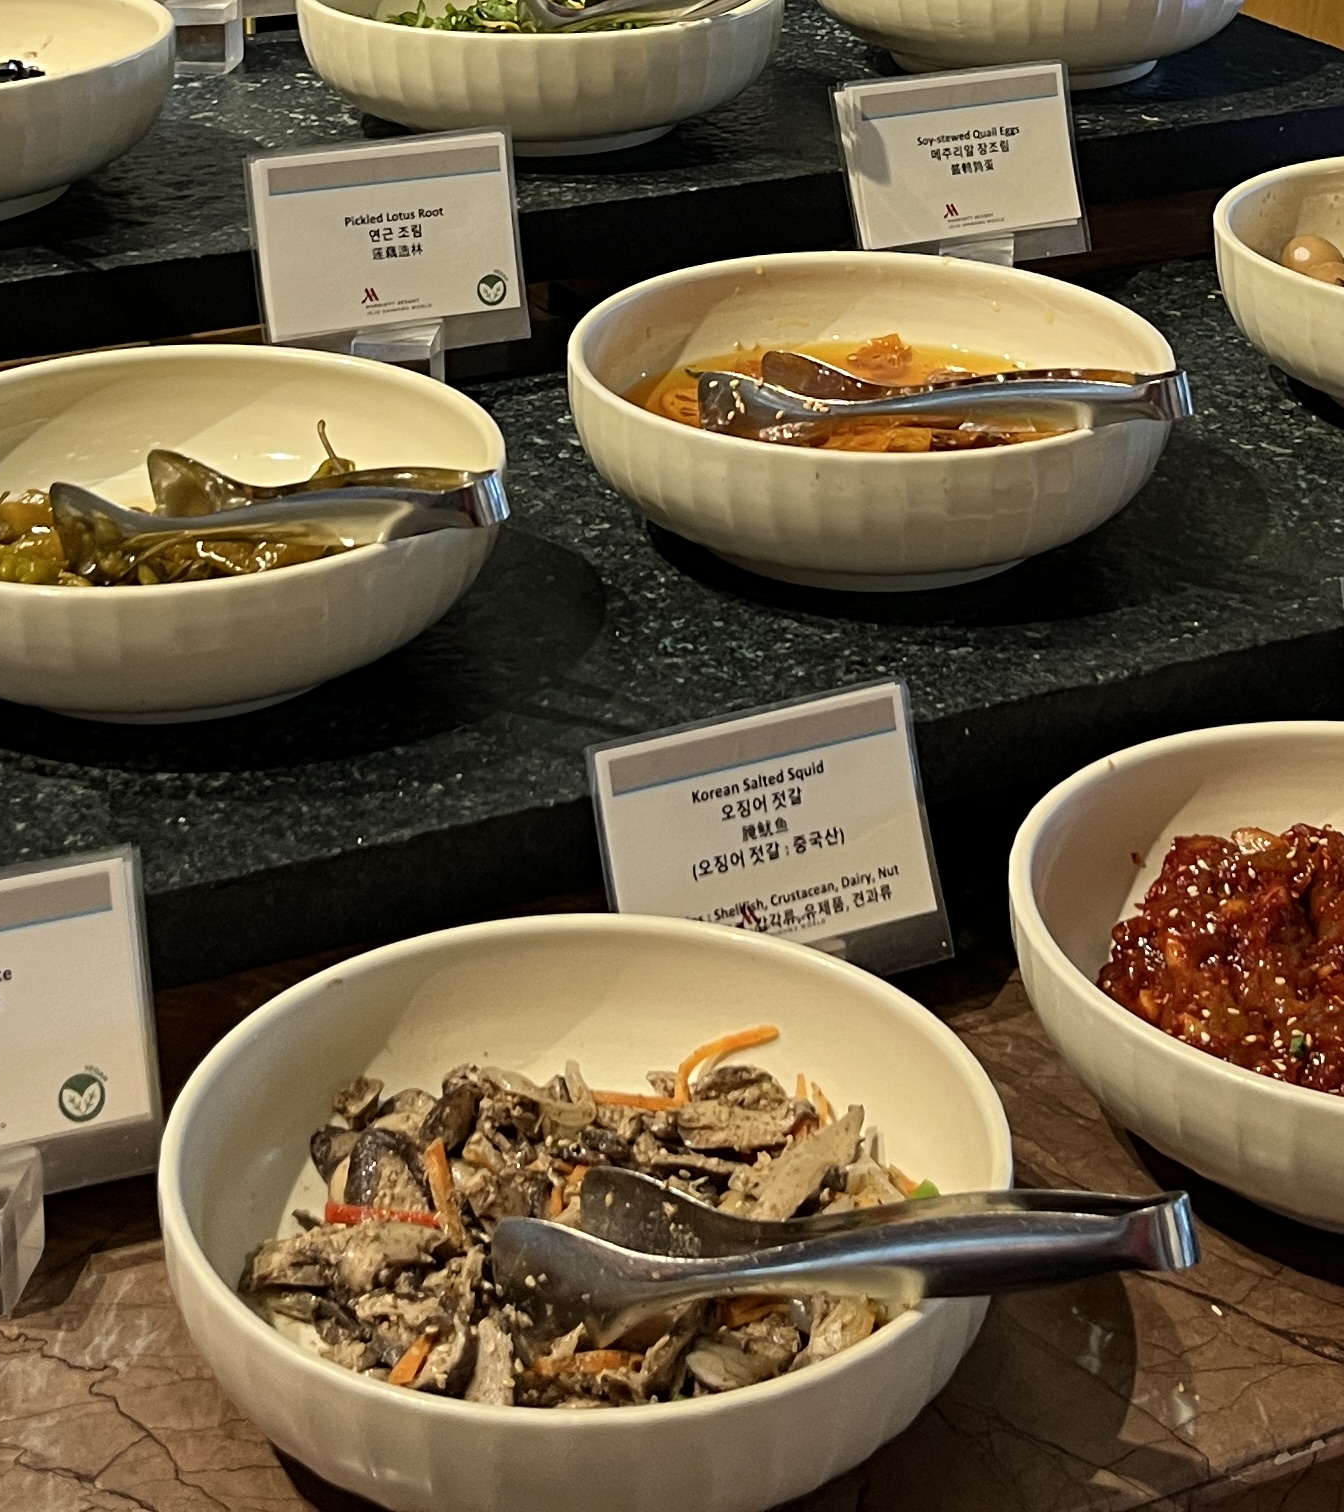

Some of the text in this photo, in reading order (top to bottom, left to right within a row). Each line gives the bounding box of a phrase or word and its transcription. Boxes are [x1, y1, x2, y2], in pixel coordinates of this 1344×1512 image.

[916, 125, 1020, 147] Soy-stewed Quail Eggs
[930, 140, 1011, 162] 메추리알 장조림
[344, 206, 444, 228] Pickled Lotus Root
[369, 224, 423, 243] 연근 조림
[691, 759, 825, 804] Korean Salted Squid
[720, 786, 803, 822] 오징어 젓갈
[691, 848, 746, 882] (오징어
[749, 841, 781, 865] 젓갈
[792, 827, 846, 855] 중국산)
[713, 898, 768, 922] Shellfish,
[769, 879, 839, 908] Crustacean,
[840, 869, 876, 892] Dairy,
[877, 864, 900, 880] Nut
[805, 894, 850, 921] 유제품,
